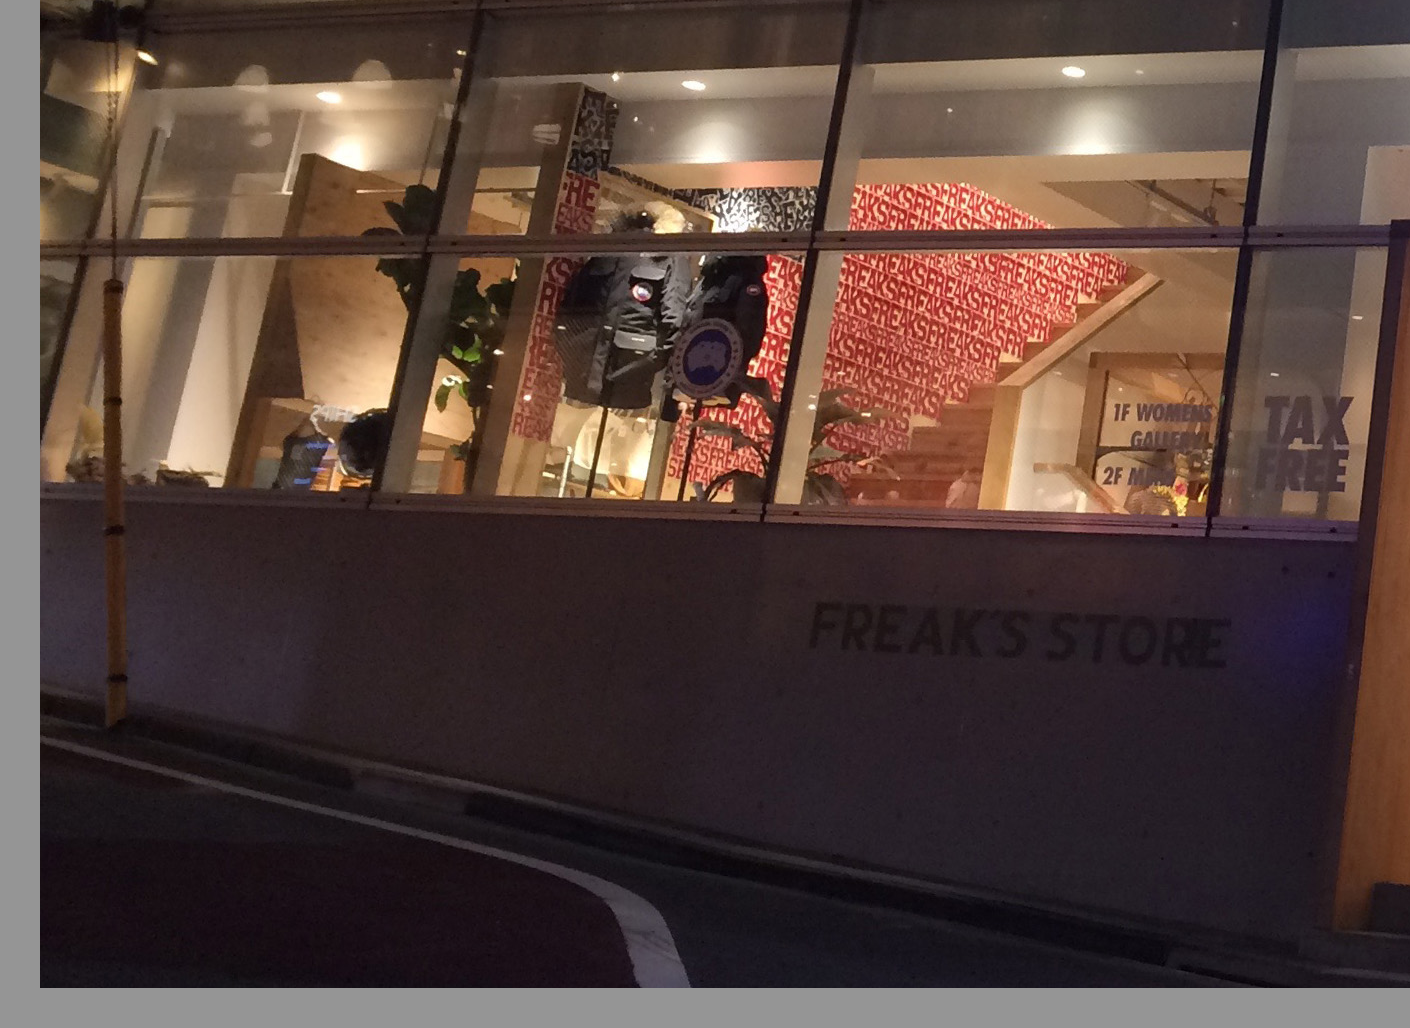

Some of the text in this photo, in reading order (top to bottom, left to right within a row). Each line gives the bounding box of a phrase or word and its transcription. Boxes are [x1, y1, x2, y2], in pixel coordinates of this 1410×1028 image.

[1113, 403, 1213, 422] 1F WOMENS
[1264, 395, 1355, 445] TAX
[1102, 466, 1123, 485] 2F
[1257, 449, 1350, 492] FREE
[808, 601, 1231, 669] FREAK'S STORE
